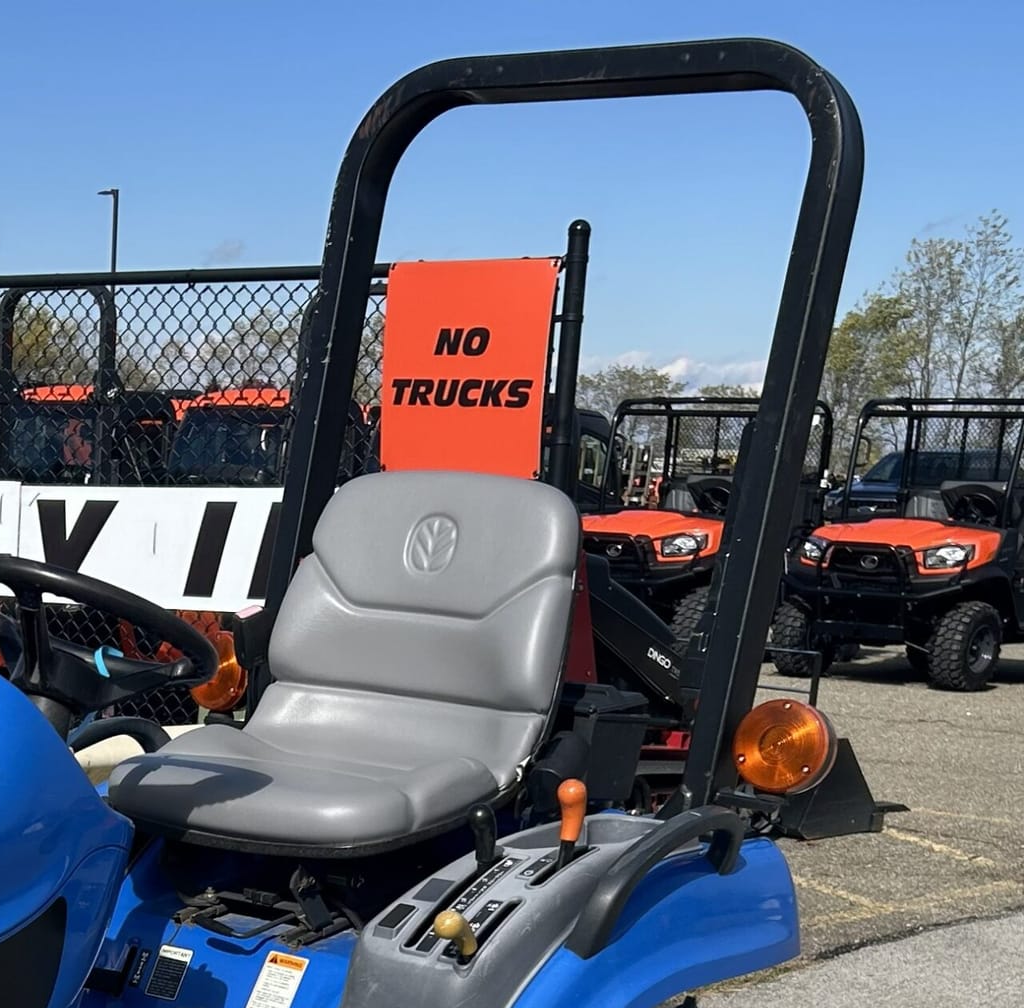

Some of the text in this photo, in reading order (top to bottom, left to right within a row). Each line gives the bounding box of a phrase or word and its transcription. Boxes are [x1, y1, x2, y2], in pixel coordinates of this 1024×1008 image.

[433, 327, 490, 356] NO
[391, 378, 534, 408] TRUCKS
[647, 647, 672, 669] DINGO
